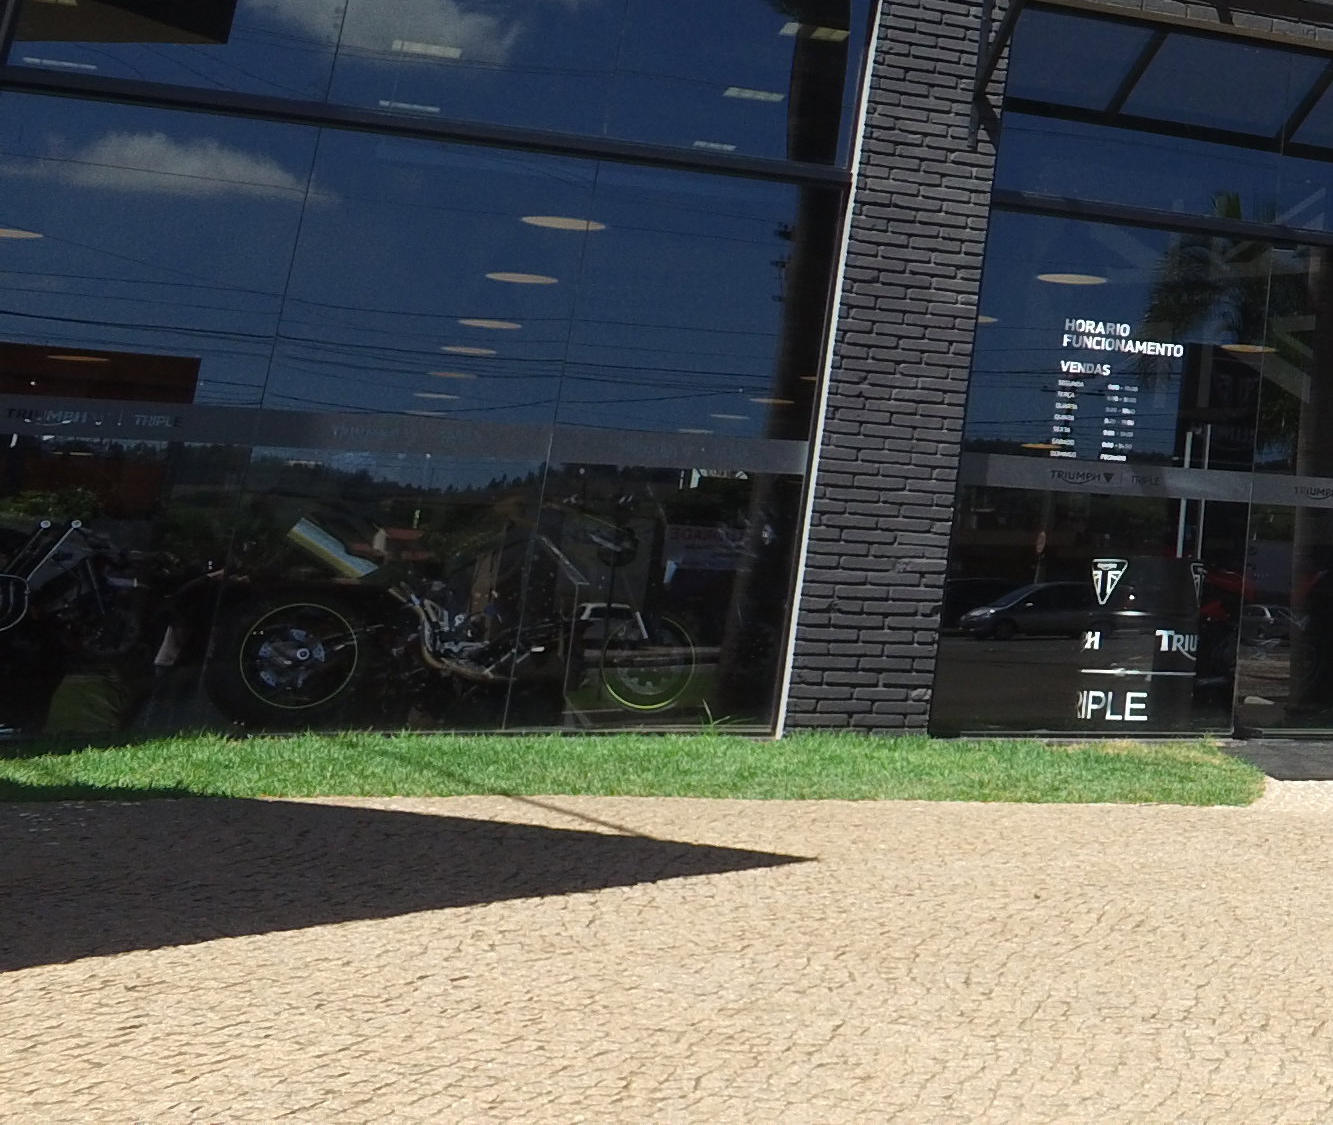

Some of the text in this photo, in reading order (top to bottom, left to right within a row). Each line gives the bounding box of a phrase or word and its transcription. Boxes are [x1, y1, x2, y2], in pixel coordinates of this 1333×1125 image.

[1064, 318, 1131, 337] HORARIO
[1062, 334, 1184, 357] FUNCIONAMENTO
[1060, 360, 1111, 376] VENDAS
